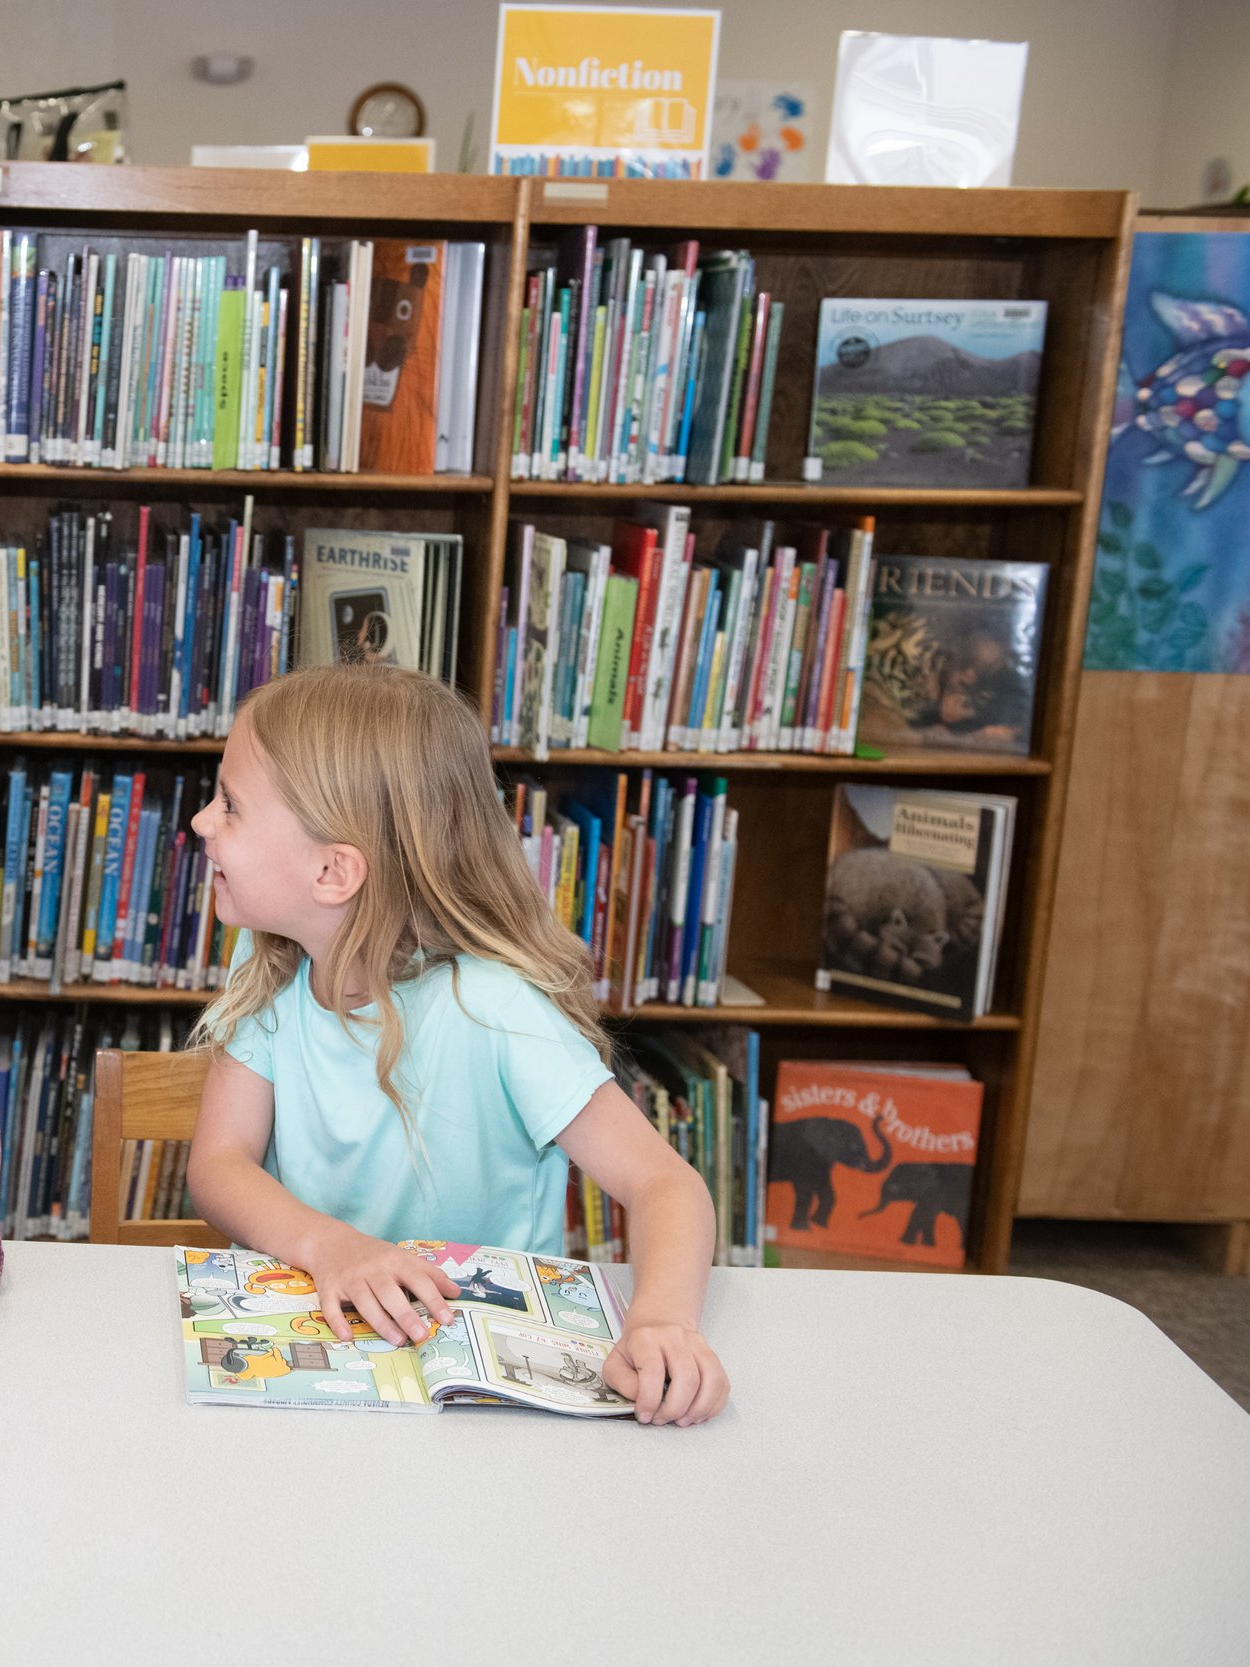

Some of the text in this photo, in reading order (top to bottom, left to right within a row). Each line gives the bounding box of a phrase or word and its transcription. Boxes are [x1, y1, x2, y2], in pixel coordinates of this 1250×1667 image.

[513, 57, 683, 93] Nonfiction
[830, 307, 862, 324] Life
[865, 311, 889, 323] on
[891, 307, 965, 334] Surtsey
[317, 545, 409, 573] EARTHRISE
[878, 564, 1035, 599] RIENDS
[608, 628, 625, 705] Animals
[899, 806, 975, 832] Animals
[43, 805, 63, 873] OCEAN
[103, 806, 123, 875] OCEAN
[894, 821, 975, 848] Hibernating
[780, 1084, 975, 1153] sisters & brothers
[292, 1398, 334, 1407] COMMUNITY
[334, 1399, 361, 1407] COUNTY
[362, 1400, 390, 1408] NEVADA
